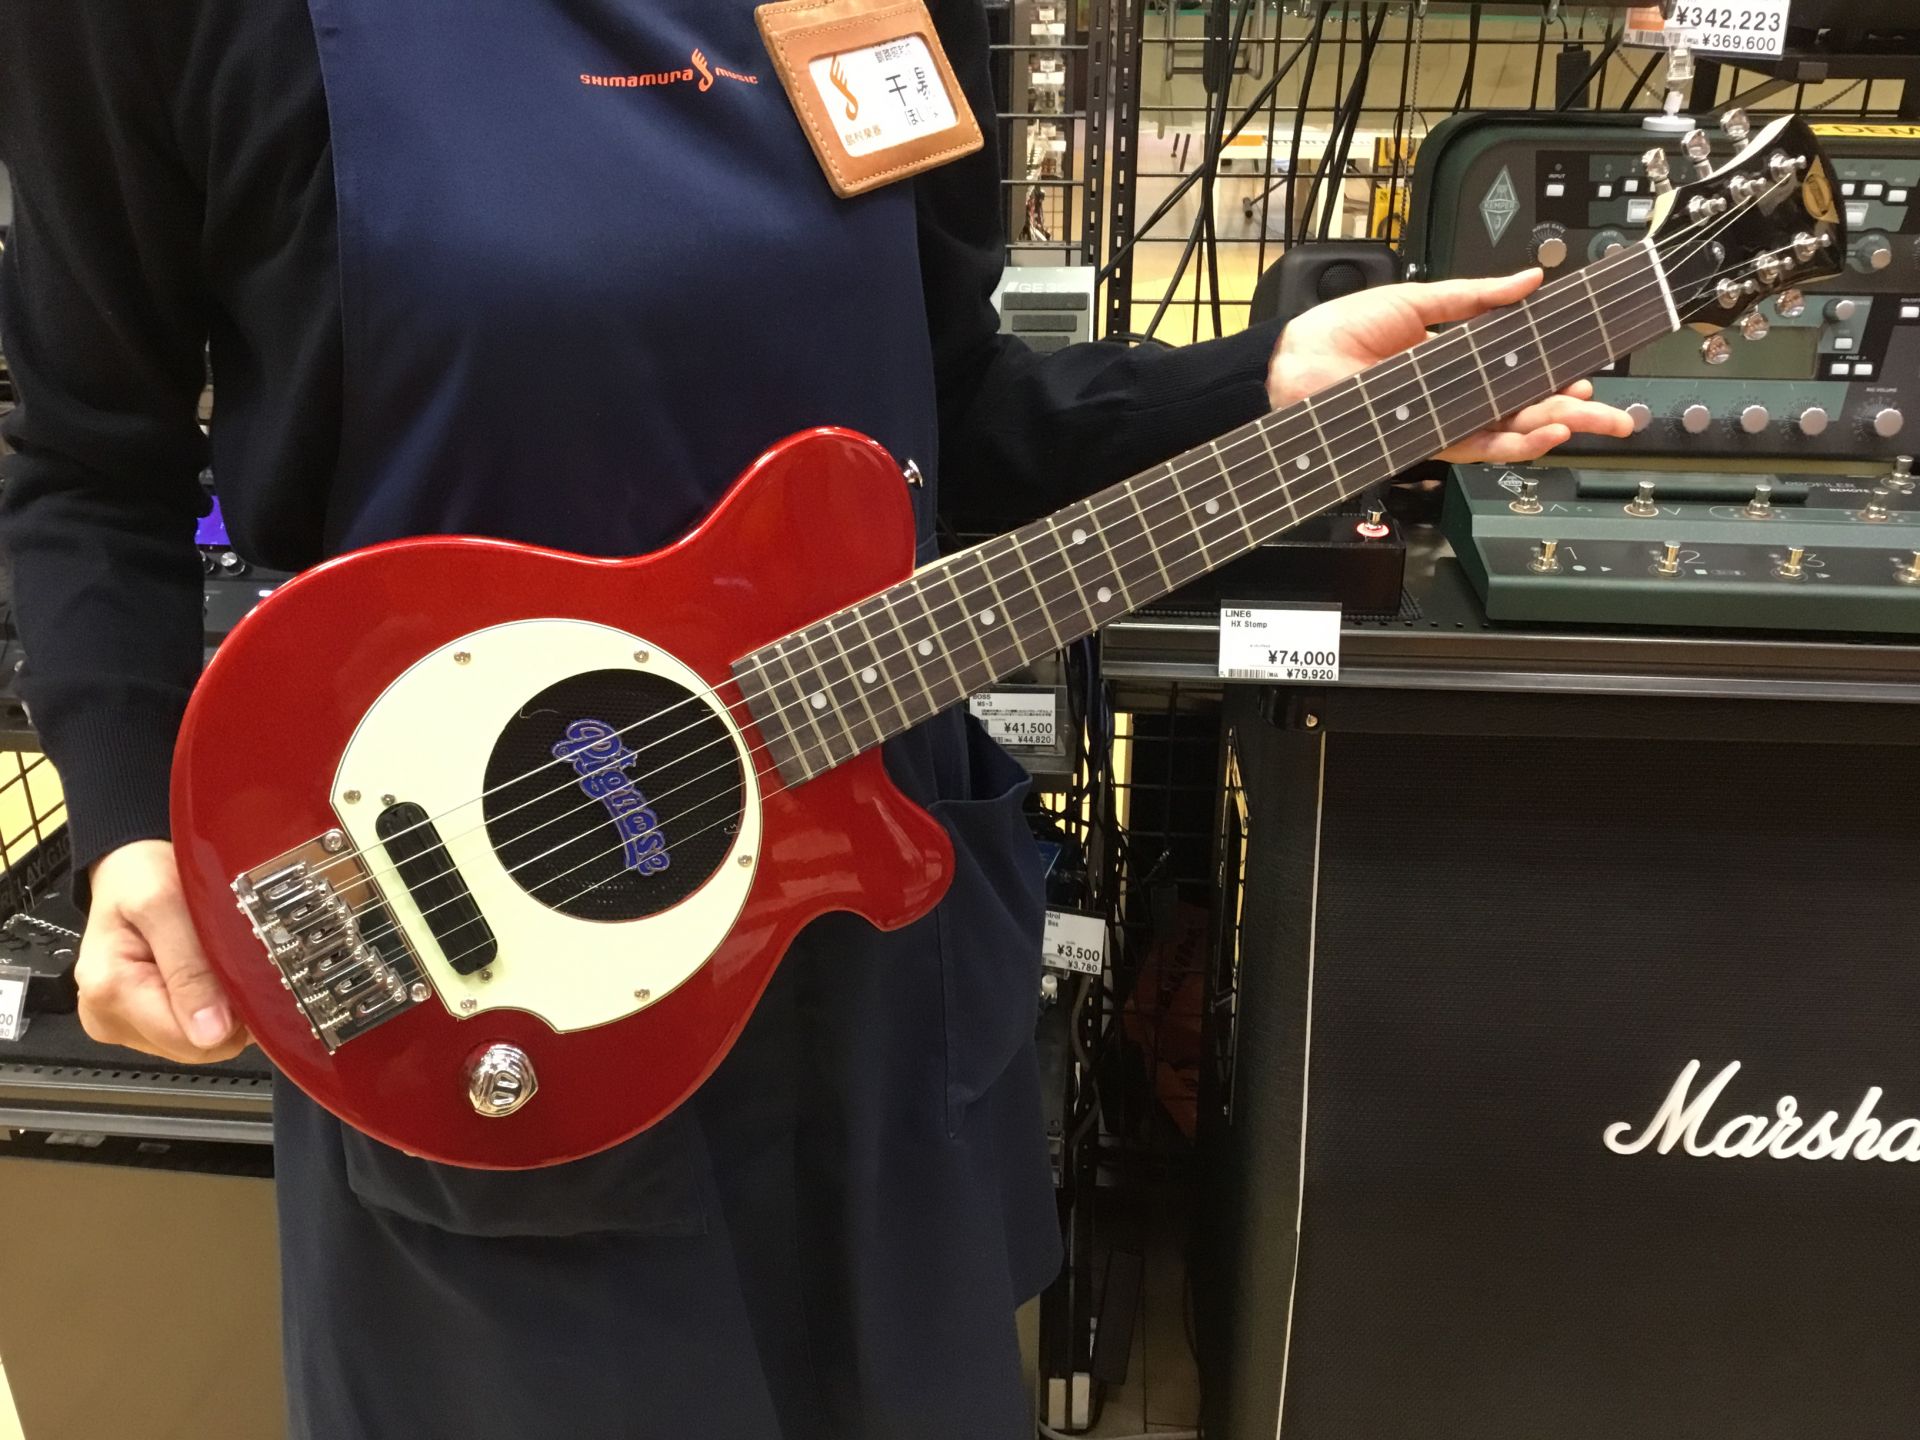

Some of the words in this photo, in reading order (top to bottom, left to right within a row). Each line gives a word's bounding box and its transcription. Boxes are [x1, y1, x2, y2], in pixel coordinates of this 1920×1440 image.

[1676, 5, 1781, 32] ¥342,223
[1702, 33, 1776, 51] ¥369,600
[1484, 201, 1515, 211] KEMPER
[1225, 610, 1252, 618] LINE6
[1231, 620, 1242, 628] HX
[1244, 620, 1268, 629] Stomp
[1268, 650, 1336, 667] ¥74,000
[1004, 722, 1053, 734] ¥41,500
[1018, 736, 1052, 744] ¥44,820
[552, 719, 671, 876] Pignose
[1057, 944, 1100, 962] ¥3,500
[1068, 960, 1098, 973] ¥3,780
